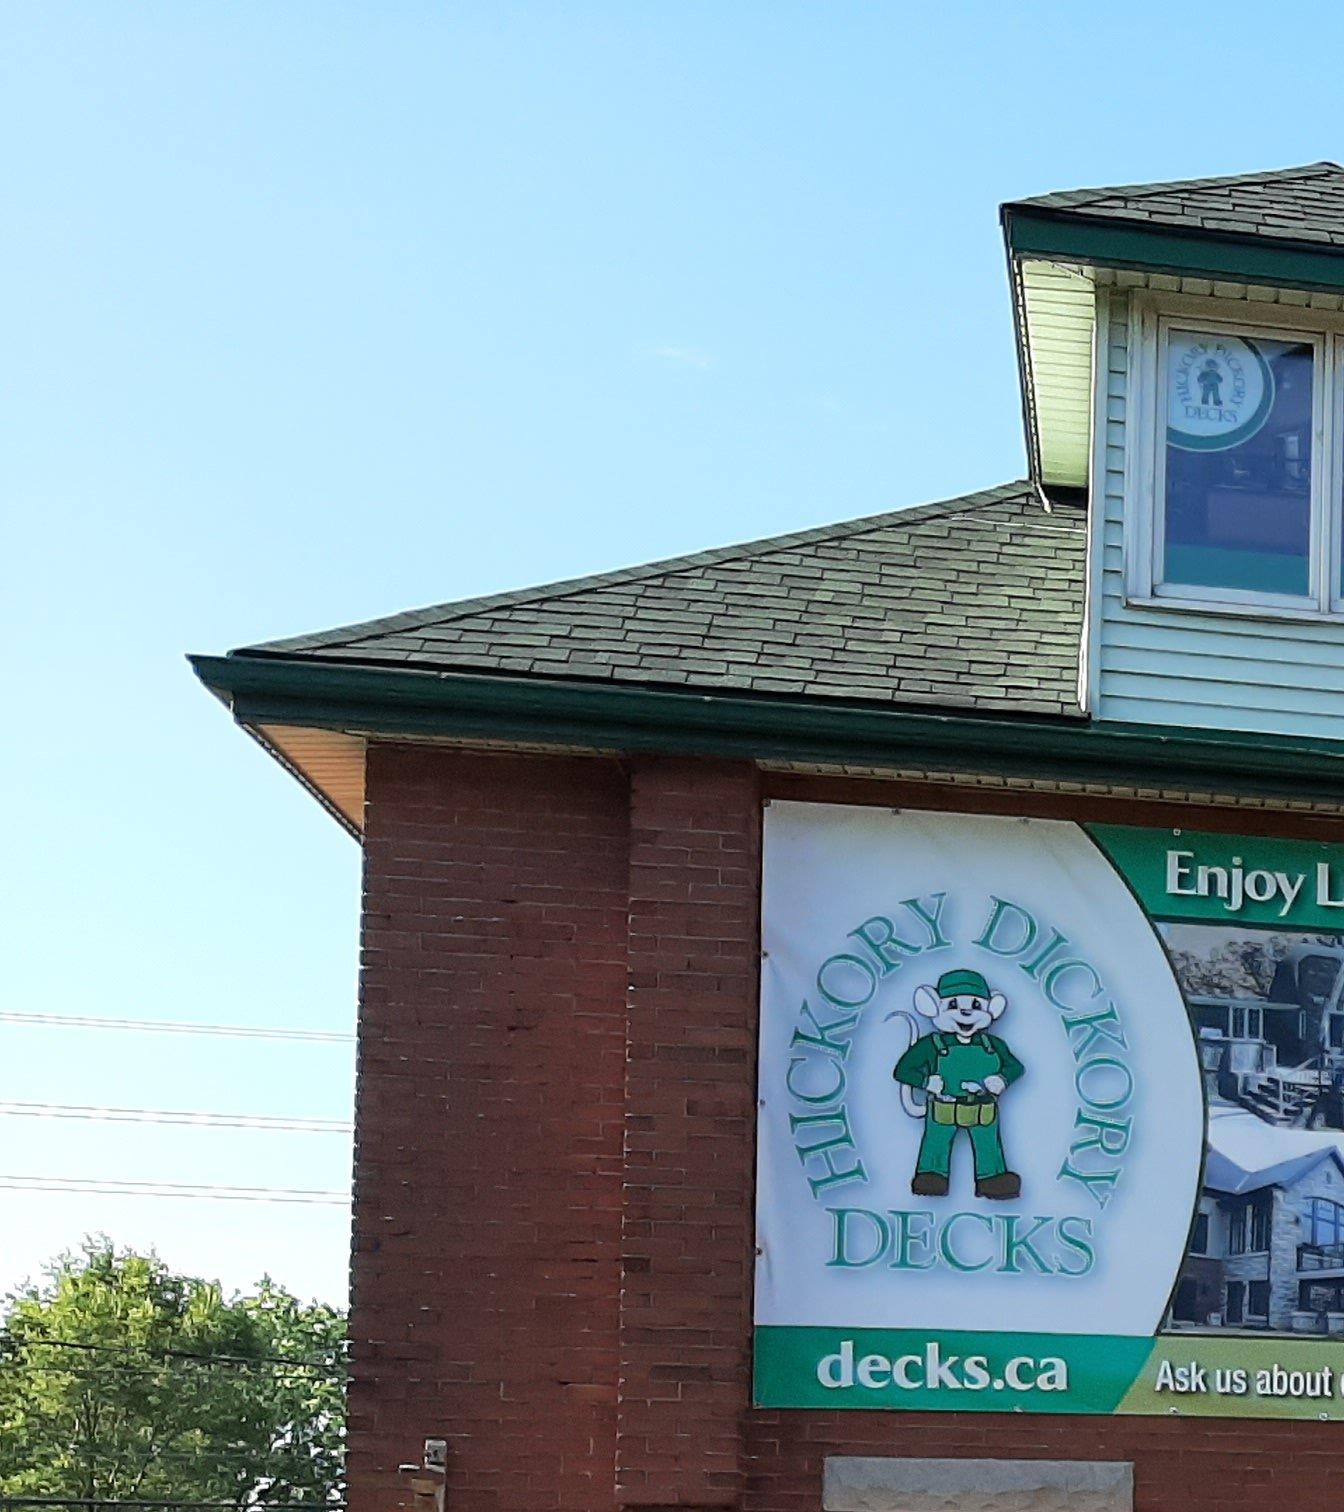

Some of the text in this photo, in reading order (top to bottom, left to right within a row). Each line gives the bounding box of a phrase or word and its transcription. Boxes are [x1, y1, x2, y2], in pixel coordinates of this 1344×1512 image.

[1165, 850, 1306, 916] Enjoy
[786, 892, 1135, 1208] HICKORY DICKORY
[825, 1207, 1095, 1276] DECKS
[816, 1340, 1068, 1391] decks.ca
[1155, 1360, 1207, 1393] Ask
[1215, 1368, 1248, 1394] us
[1256, 1364, 1333, 1398] about
